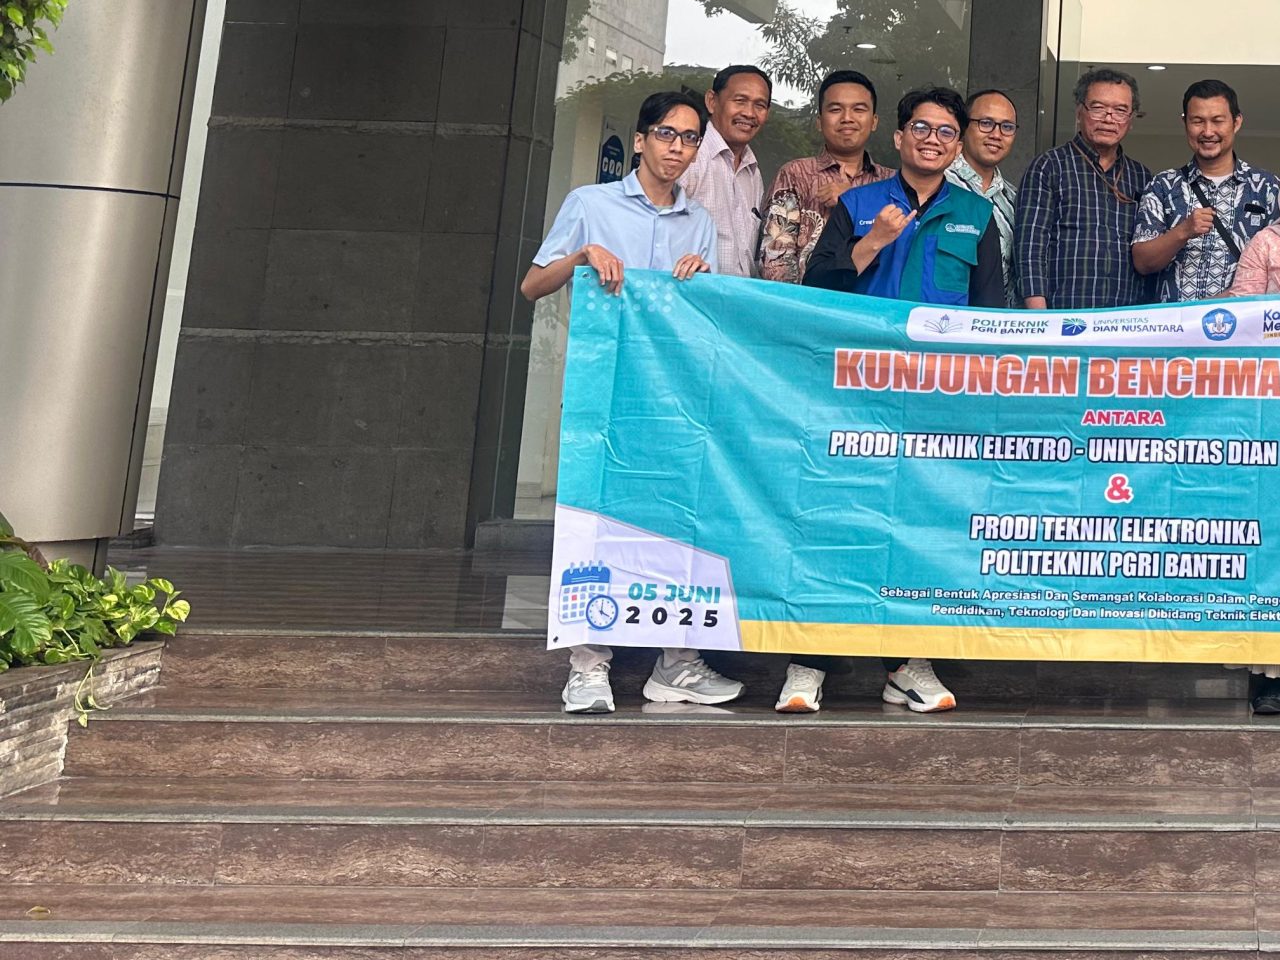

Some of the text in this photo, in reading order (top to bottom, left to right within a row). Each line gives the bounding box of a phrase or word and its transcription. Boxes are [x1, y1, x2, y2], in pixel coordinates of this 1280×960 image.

[971, 325, 1045, 334] PGRI BANTEN
[972, 318, 1049, 328] POLITEKNIK
[1093, 317, 1149, 326] UNIVERSITAS
[1093, 324, 1184, 333] DIAN NUSANTARA
[834, 349, 1079, 397] KUNJUNGAN
[1081, 409, 1165, 427] ANTARA
[829, 431, 897, 457] PRODI
[902, 433, 979, 460] TEKNIK
[982, 435, 1071, 463] ELEKTRO
[1088, 438, 1223, 466] UNIVERSITAS
[1226, 442, 1278, 467] DIAN
[1104, 474, 1133, 504] &
[970, 514, 1262, 546] PRODI TEKNIK ELEKTRONIKA
[980, 549, 1246, 580] POLITEKNIK PGRI BANTEN
[627, 582, 721, 604] 05 JUNI
[880, 587, 931, 600] Sebagai
[934, 588, 978, 600] Bentuk
[982, 589, 1041, 602] Apresiasi
[1045, 591, 1069, 601] Dan
[1072, 590, 1134, 603] Semangat
[1138, 592, 1204, 604] Kolaborasi
[1207, 593, 1246, 605] Dalam
[625, 606, 718, 628] 2025
[931, 604, 1005, 618] Pendidikan,
[1008, 606, 1068, 619] Teknologi
[1072, 608, 1097, 618] Dan
[1100, 608, 1144, 619] Inovasi
[1148, 608, 1201, 622] Dibidang
[1205, 609, 1246, 621] Teknik
